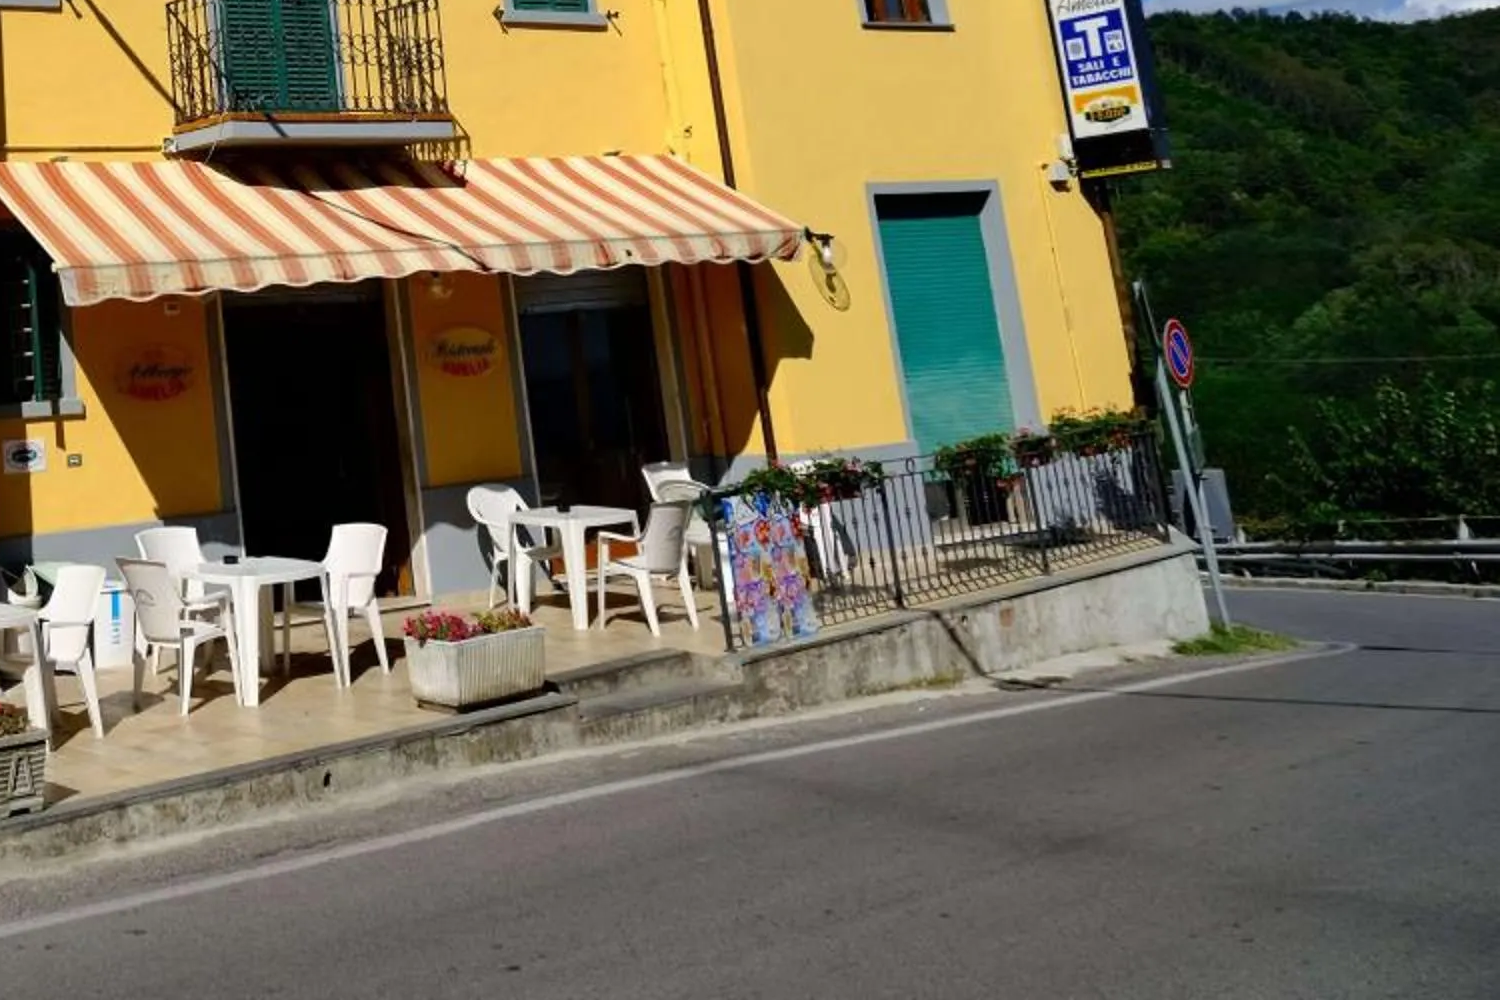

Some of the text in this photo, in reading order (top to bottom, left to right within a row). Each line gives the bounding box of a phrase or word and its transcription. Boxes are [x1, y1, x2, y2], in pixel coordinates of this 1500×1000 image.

[1074, 15, 1109, 57] T
[1077, 55, 1121, 73] SALI E
[1072, 67, 1132, 86] TABACCHI
